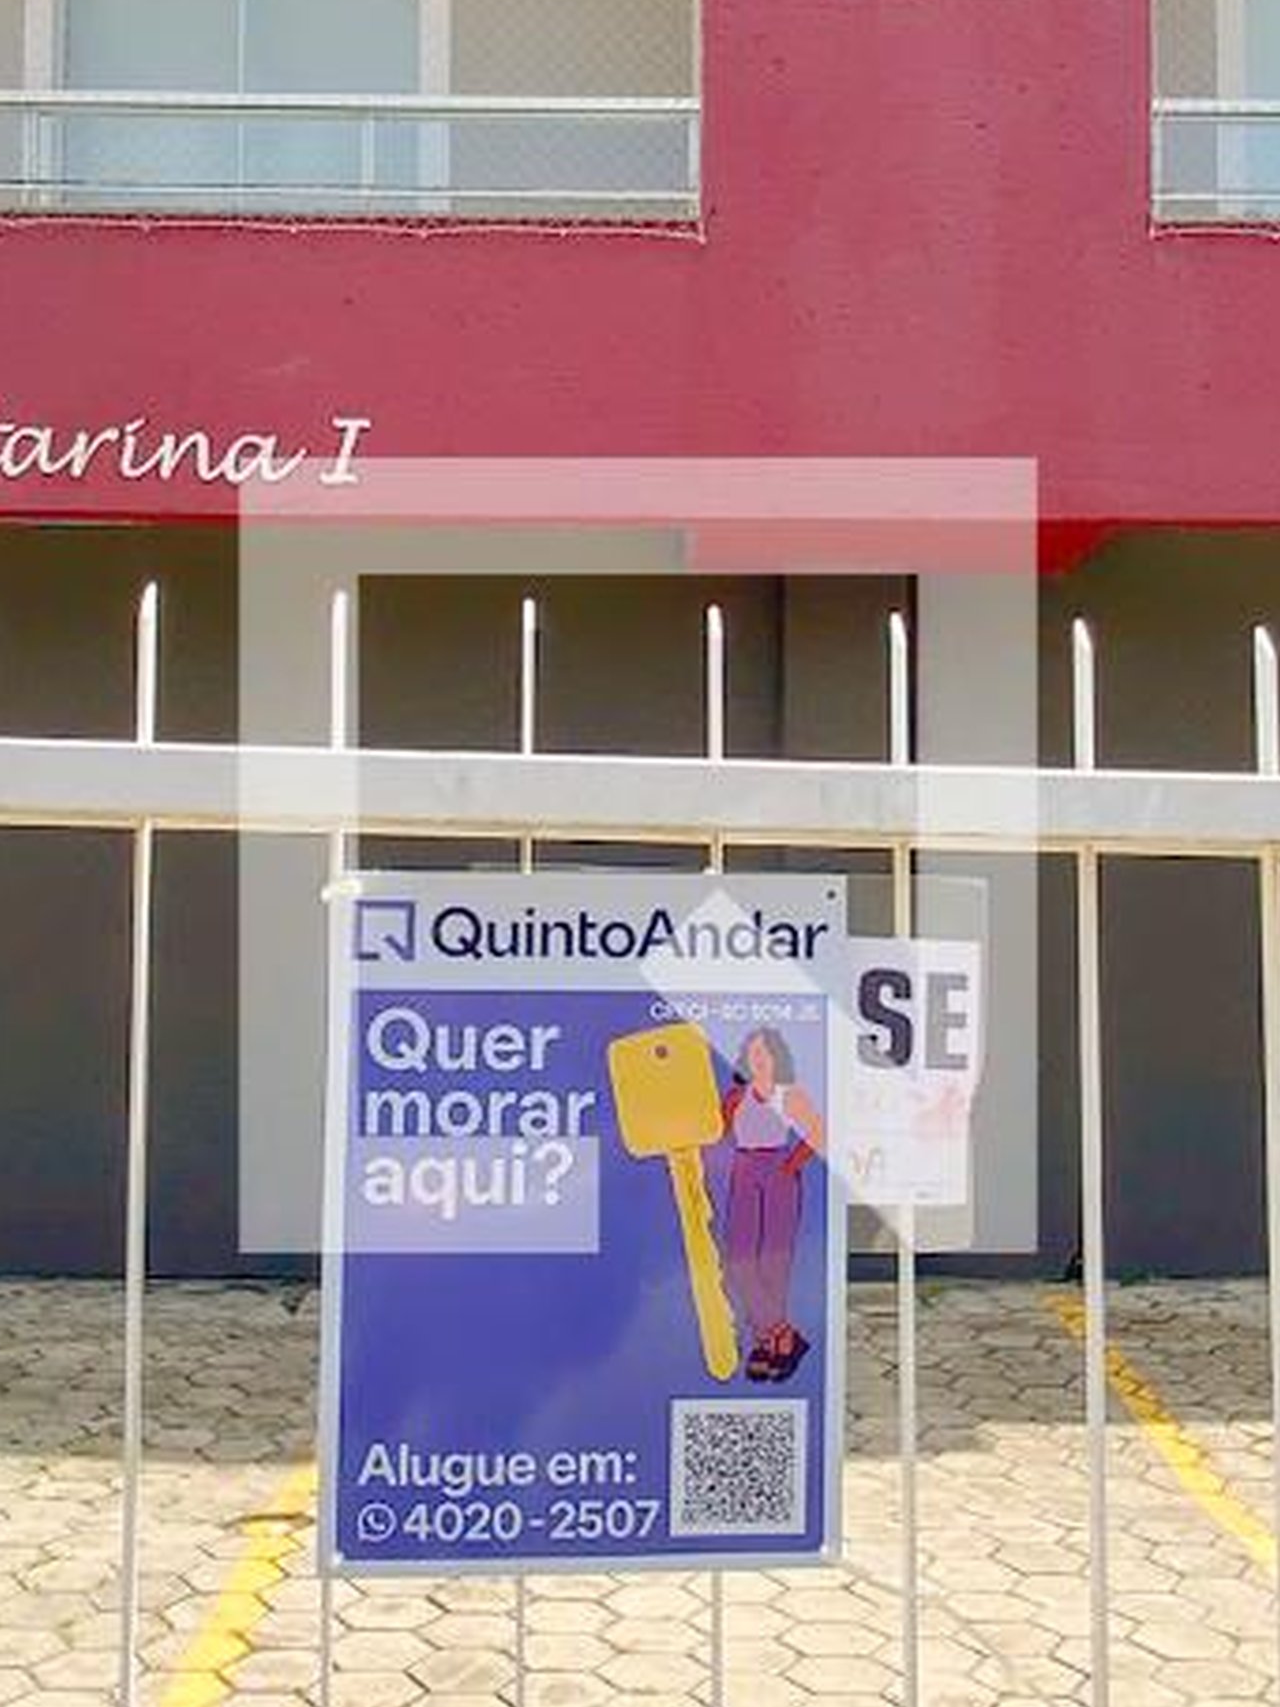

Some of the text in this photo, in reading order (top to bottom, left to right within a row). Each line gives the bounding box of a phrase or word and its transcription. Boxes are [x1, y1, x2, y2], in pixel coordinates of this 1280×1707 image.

[320, 417, 372, 486] I
[431, 906, 829, 960] QuintoAndar
[367, 1007, 562, 1073] Quer
[365, 1089, 597, 1137] morar
[363, 1141, 574, 1219] aqui?
[358, 1444, 638, 1497] Alugue em:
